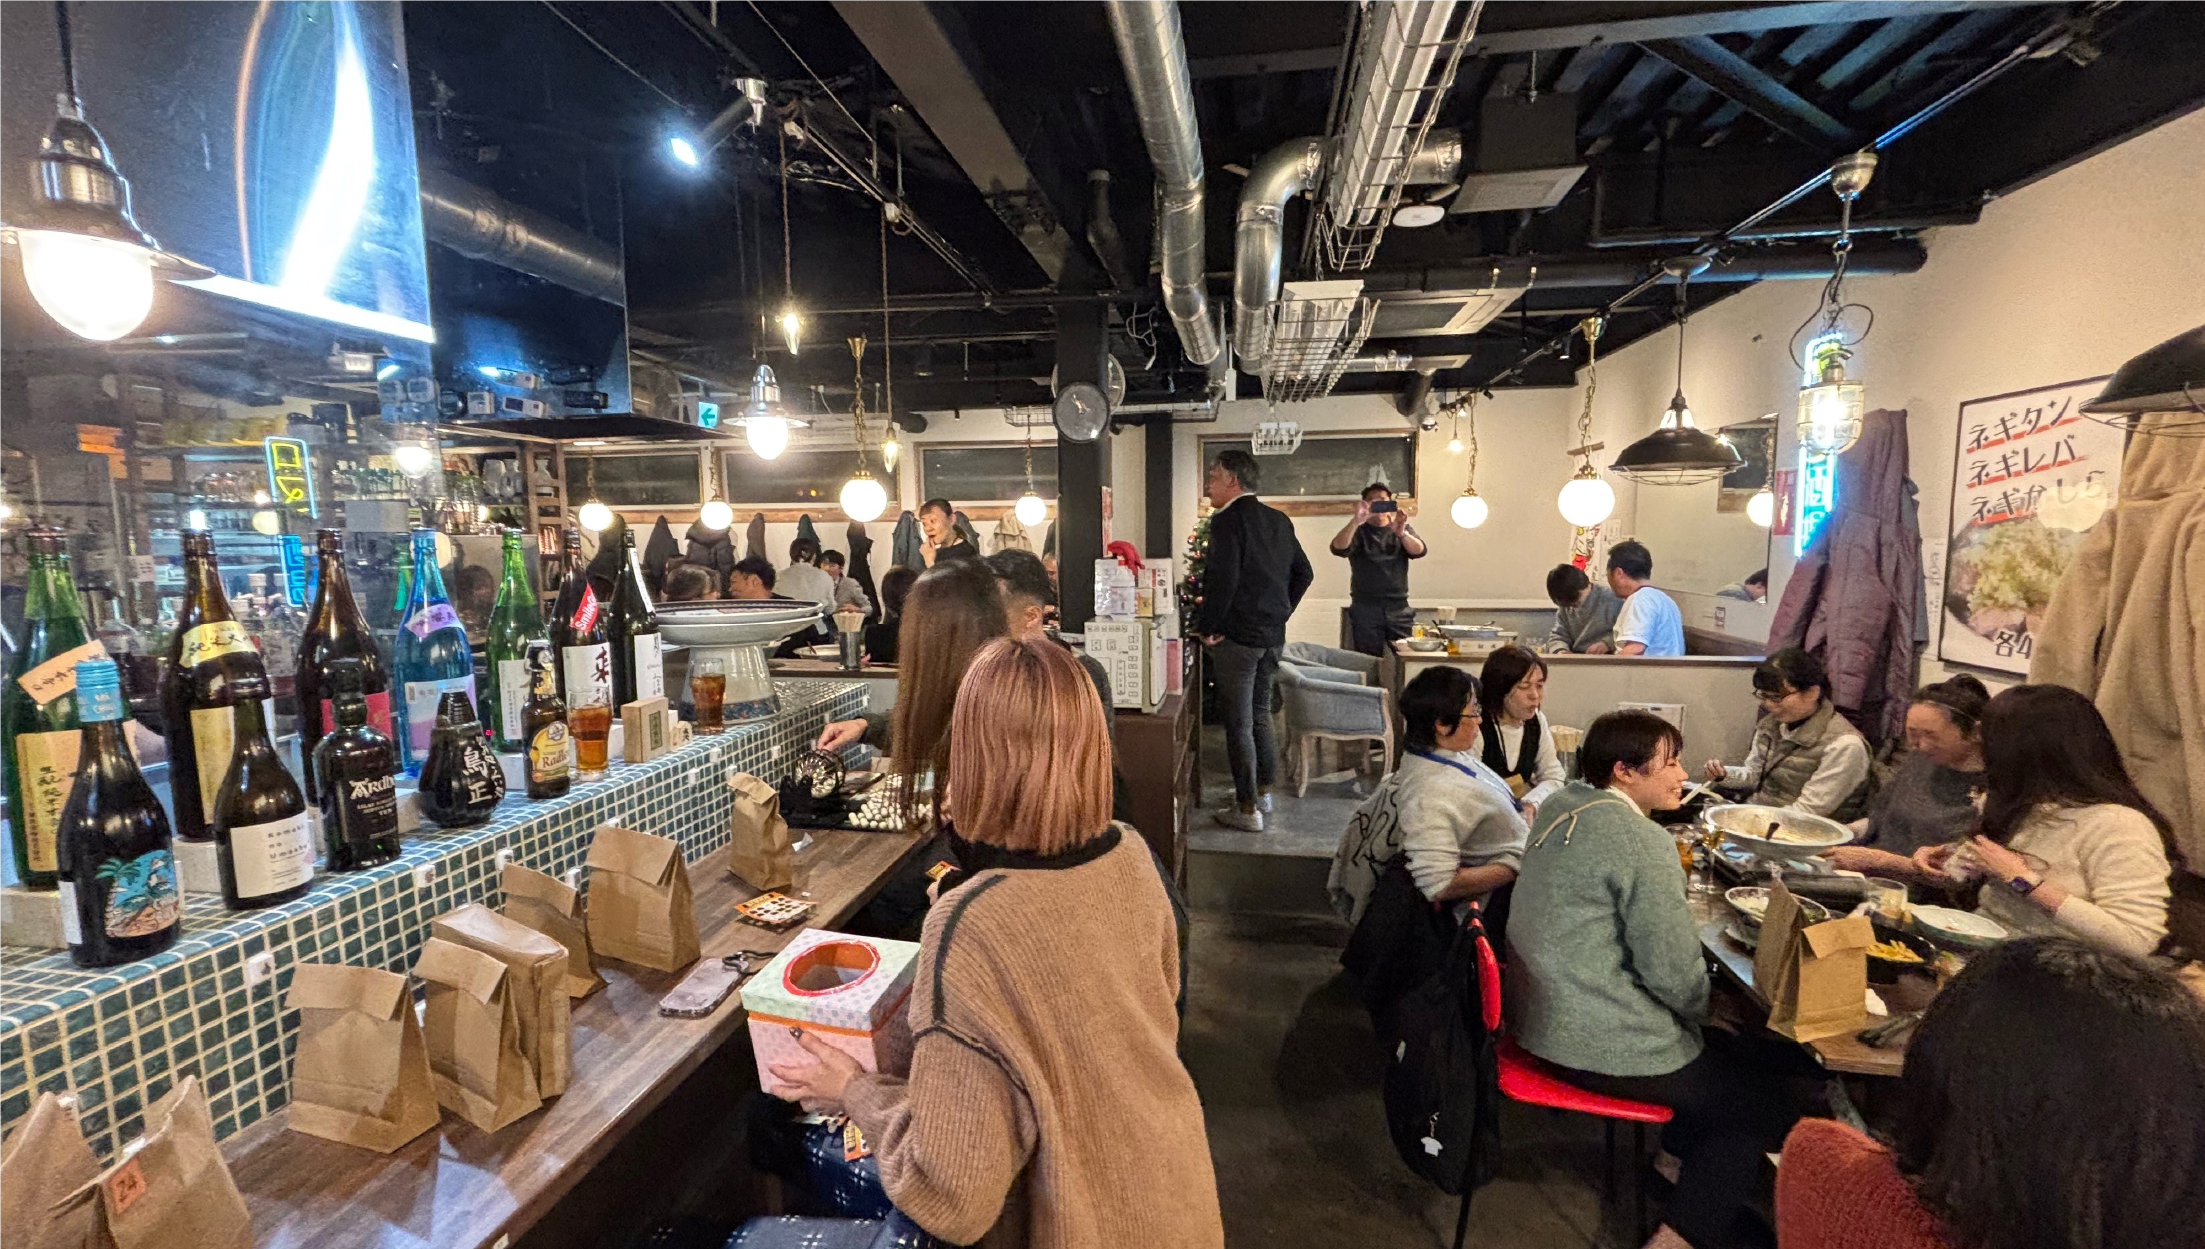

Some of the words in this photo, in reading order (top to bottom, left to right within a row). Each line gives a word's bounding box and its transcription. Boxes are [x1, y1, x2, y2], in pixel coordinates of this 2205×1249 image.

[1968, 396, 2072, 450] ネギタン
[1969, 434, 2075, 486] ネギレバ
